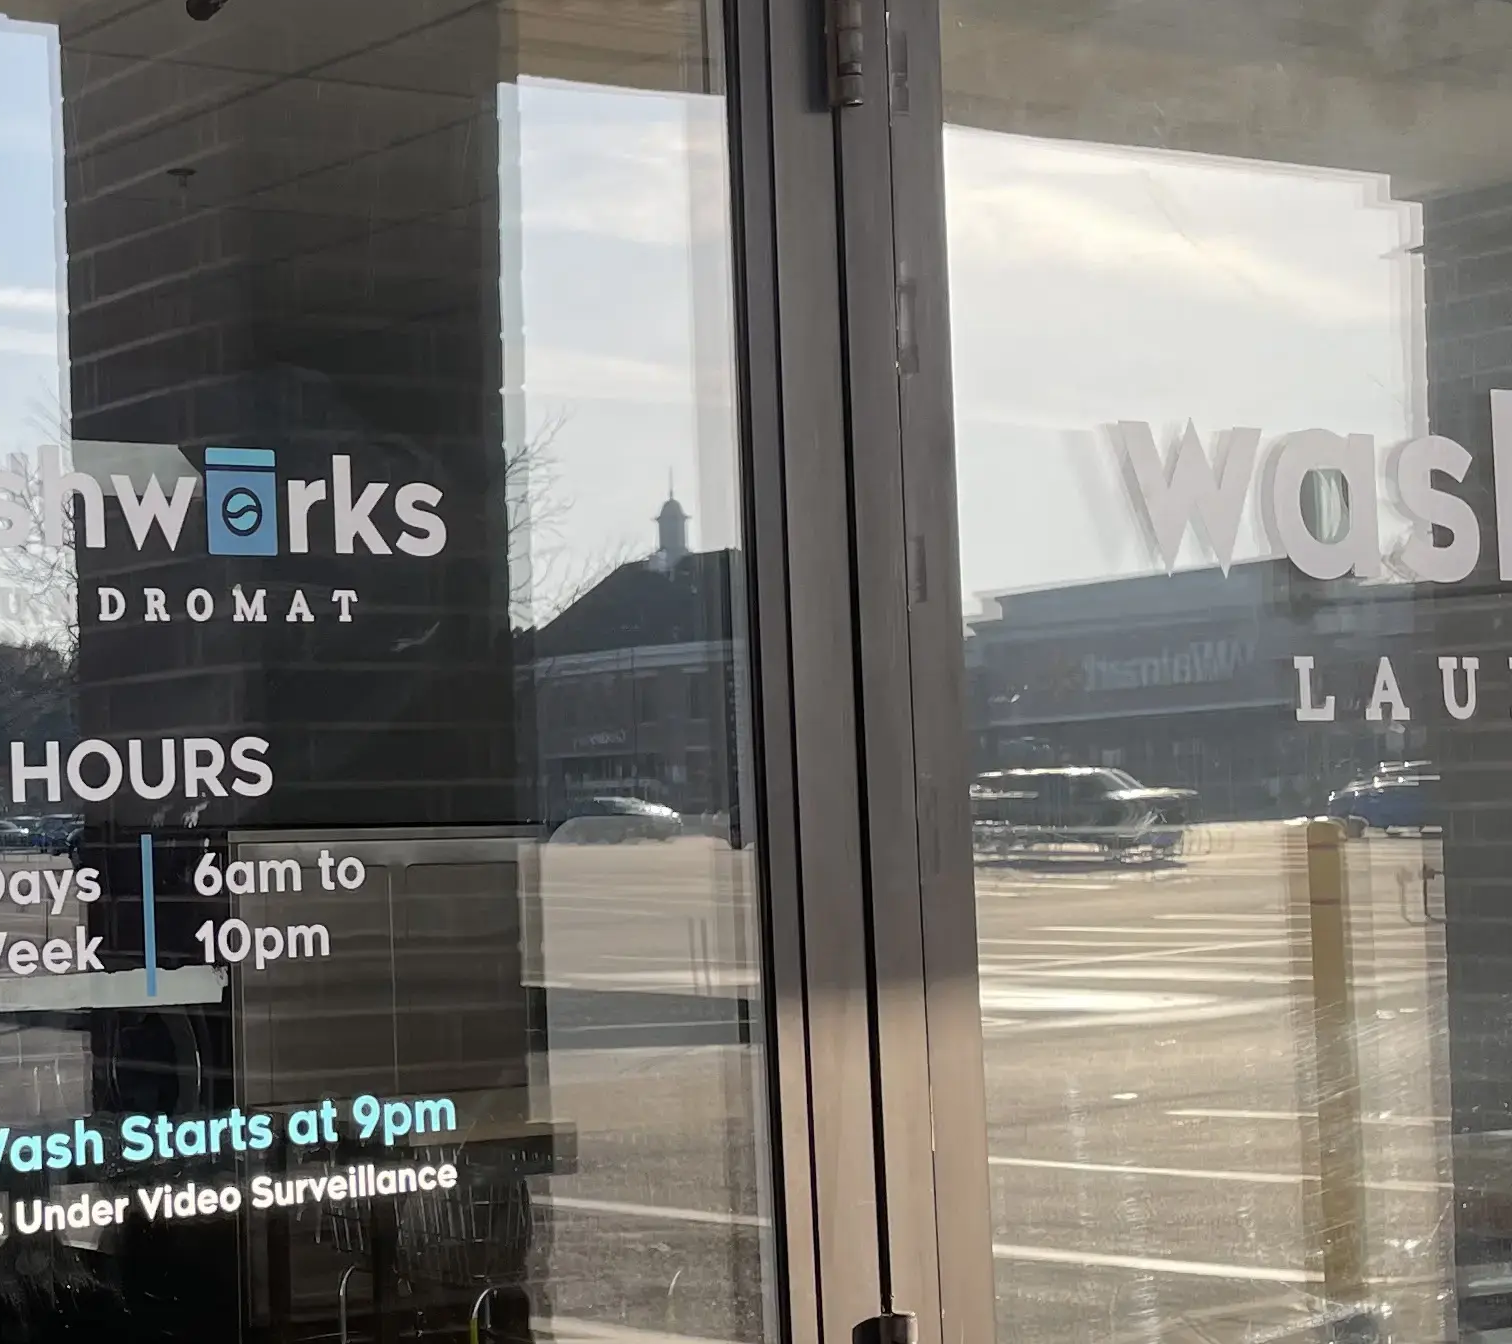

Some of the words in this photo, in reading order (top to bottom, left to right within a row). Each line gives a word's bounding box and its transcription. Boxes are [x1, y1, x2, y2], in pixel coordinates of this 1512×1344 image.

[1292, 655, 1512, 722] LAU
[10, 736, 274, 804] HOURS
[194, 852, 302, 896] 6am
[318, 849, 366, 892] to
[194, 919, 331, 970] 10pm
[121, 1106, 274, 1162] Starts
[288, 1100, 338, 1146] at
[352, 1094, 457, 1147] 9pm
[15, 1193, 130, 1236] Under
[137, 1182, 242, 1220] Video
[251, 1163, 459, 1209] Surveillance
